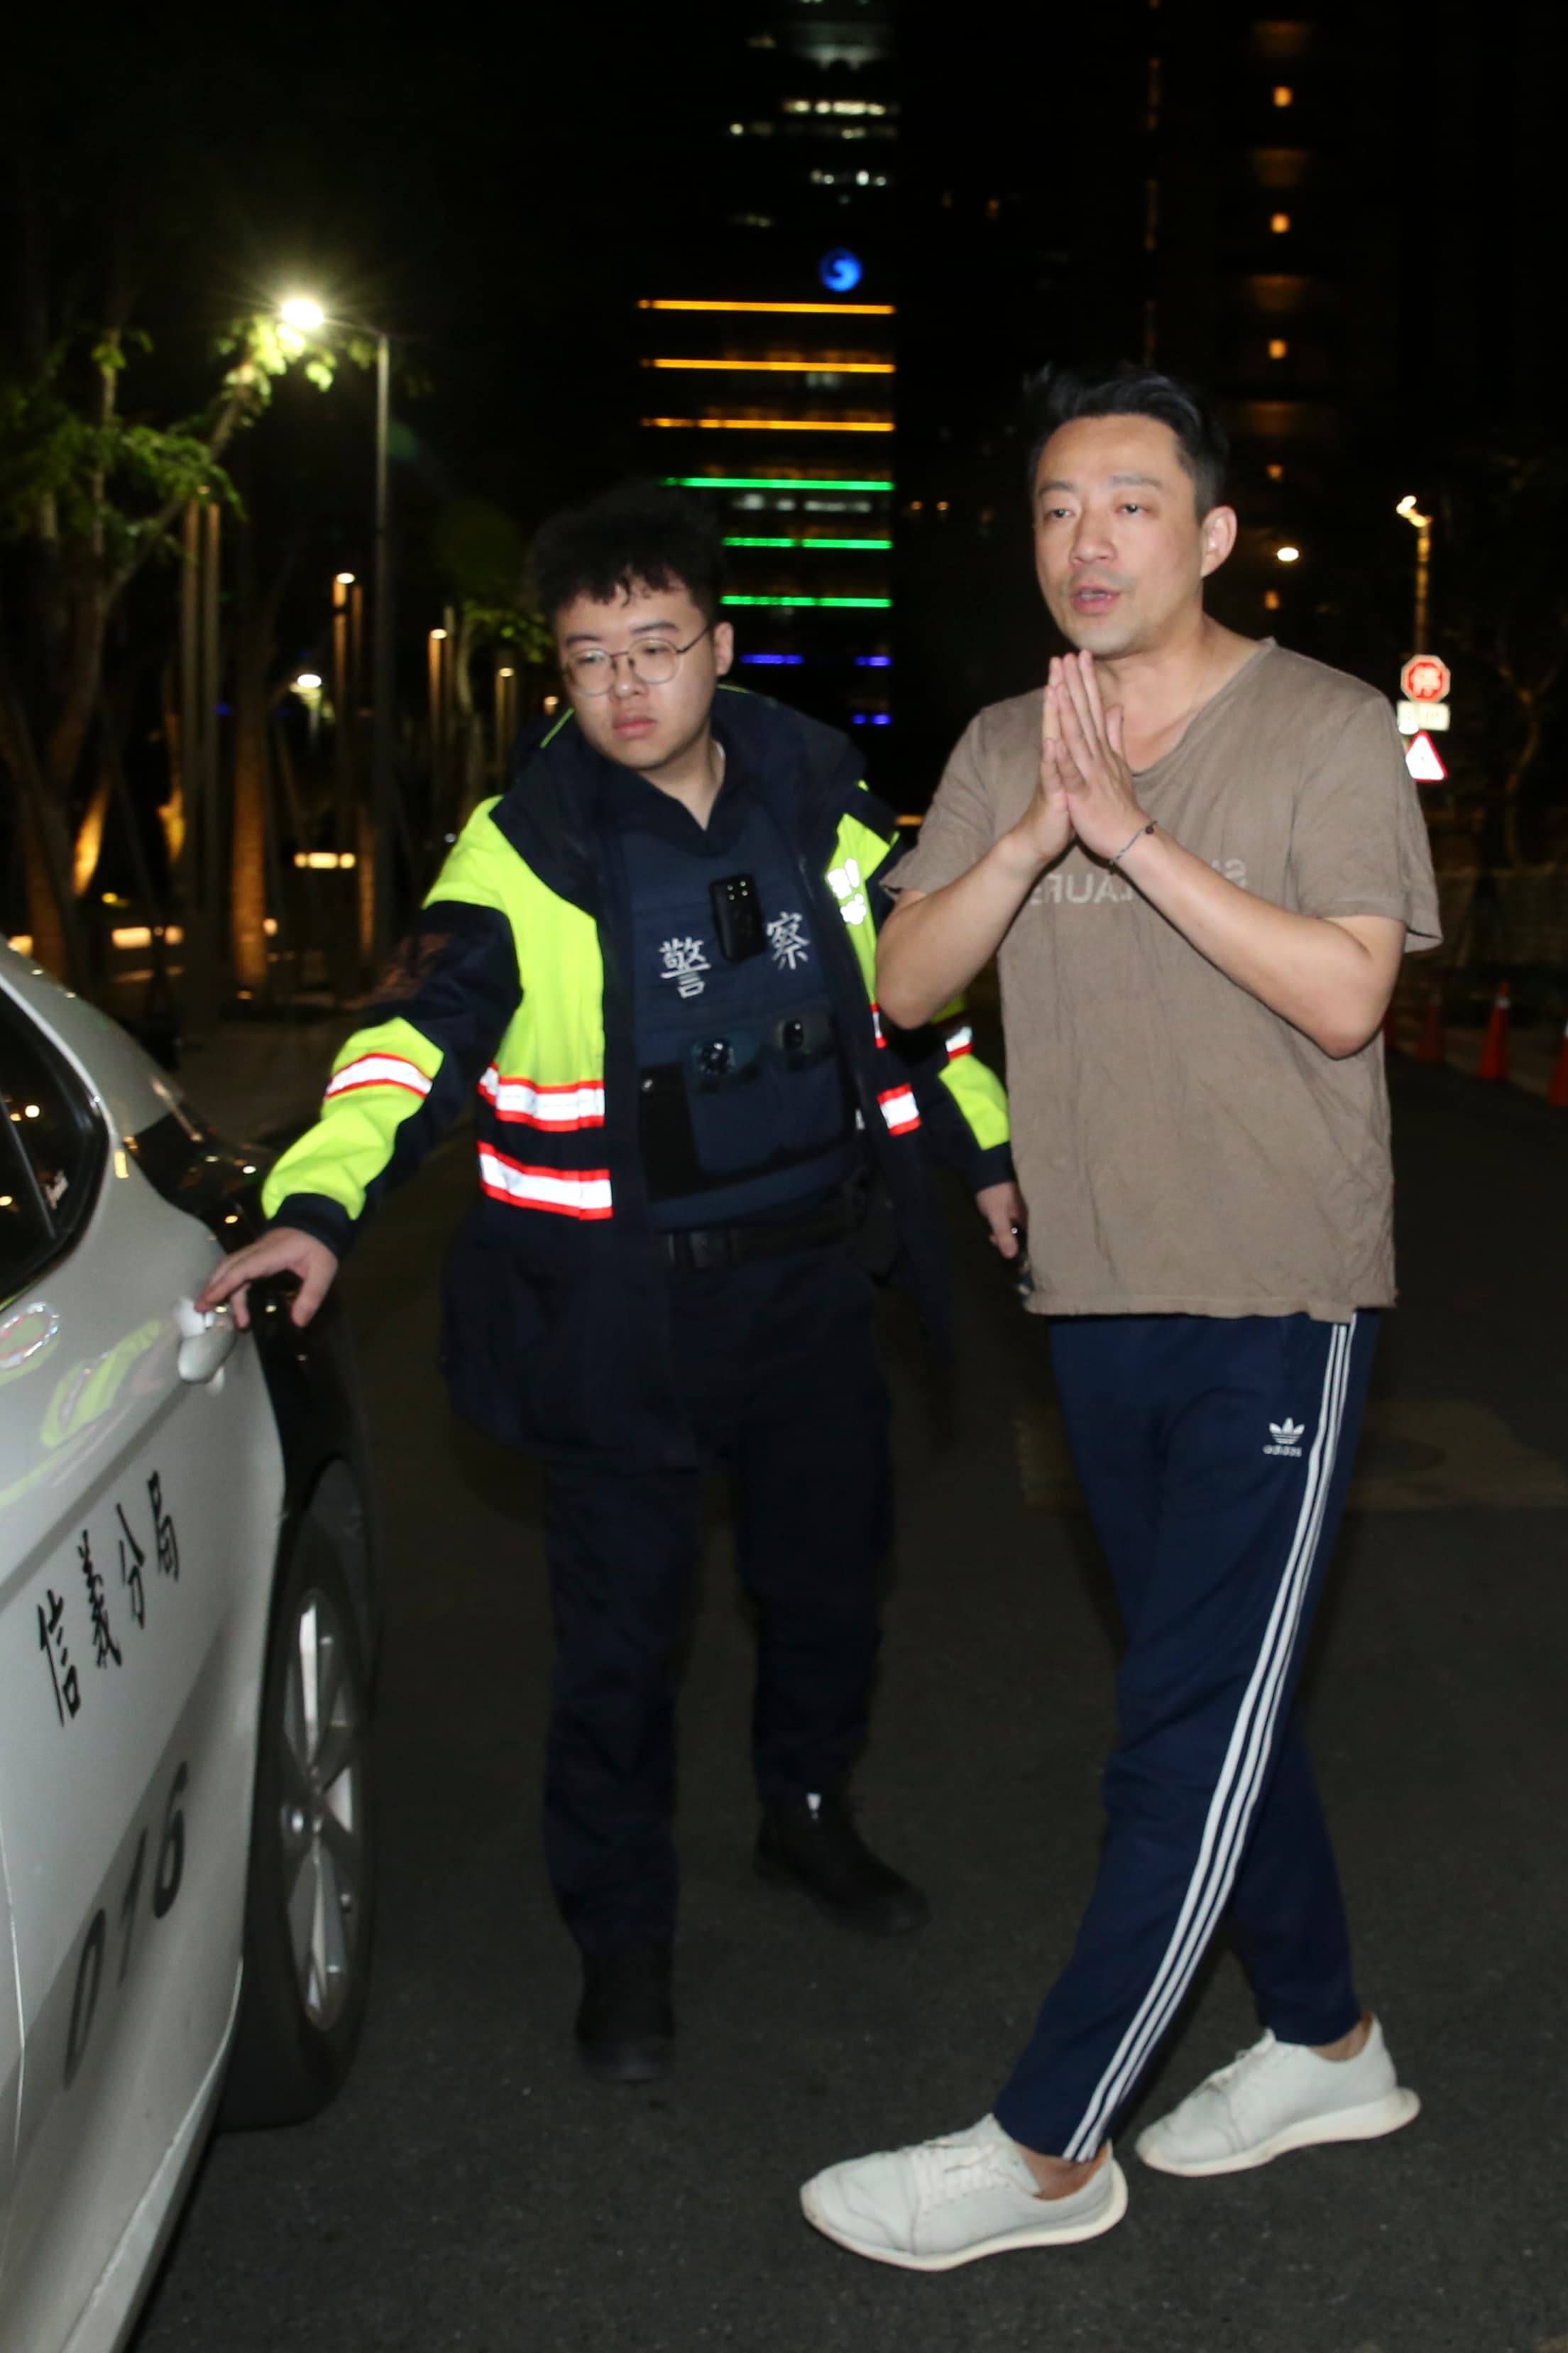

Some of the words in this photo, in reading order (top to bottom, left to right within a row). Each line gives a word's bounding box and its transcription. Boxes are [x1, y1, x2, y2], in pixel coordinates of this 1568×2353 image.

[659, 911, 810, 998] 警察
[37, 1470, 179, 1727] 信義分局
